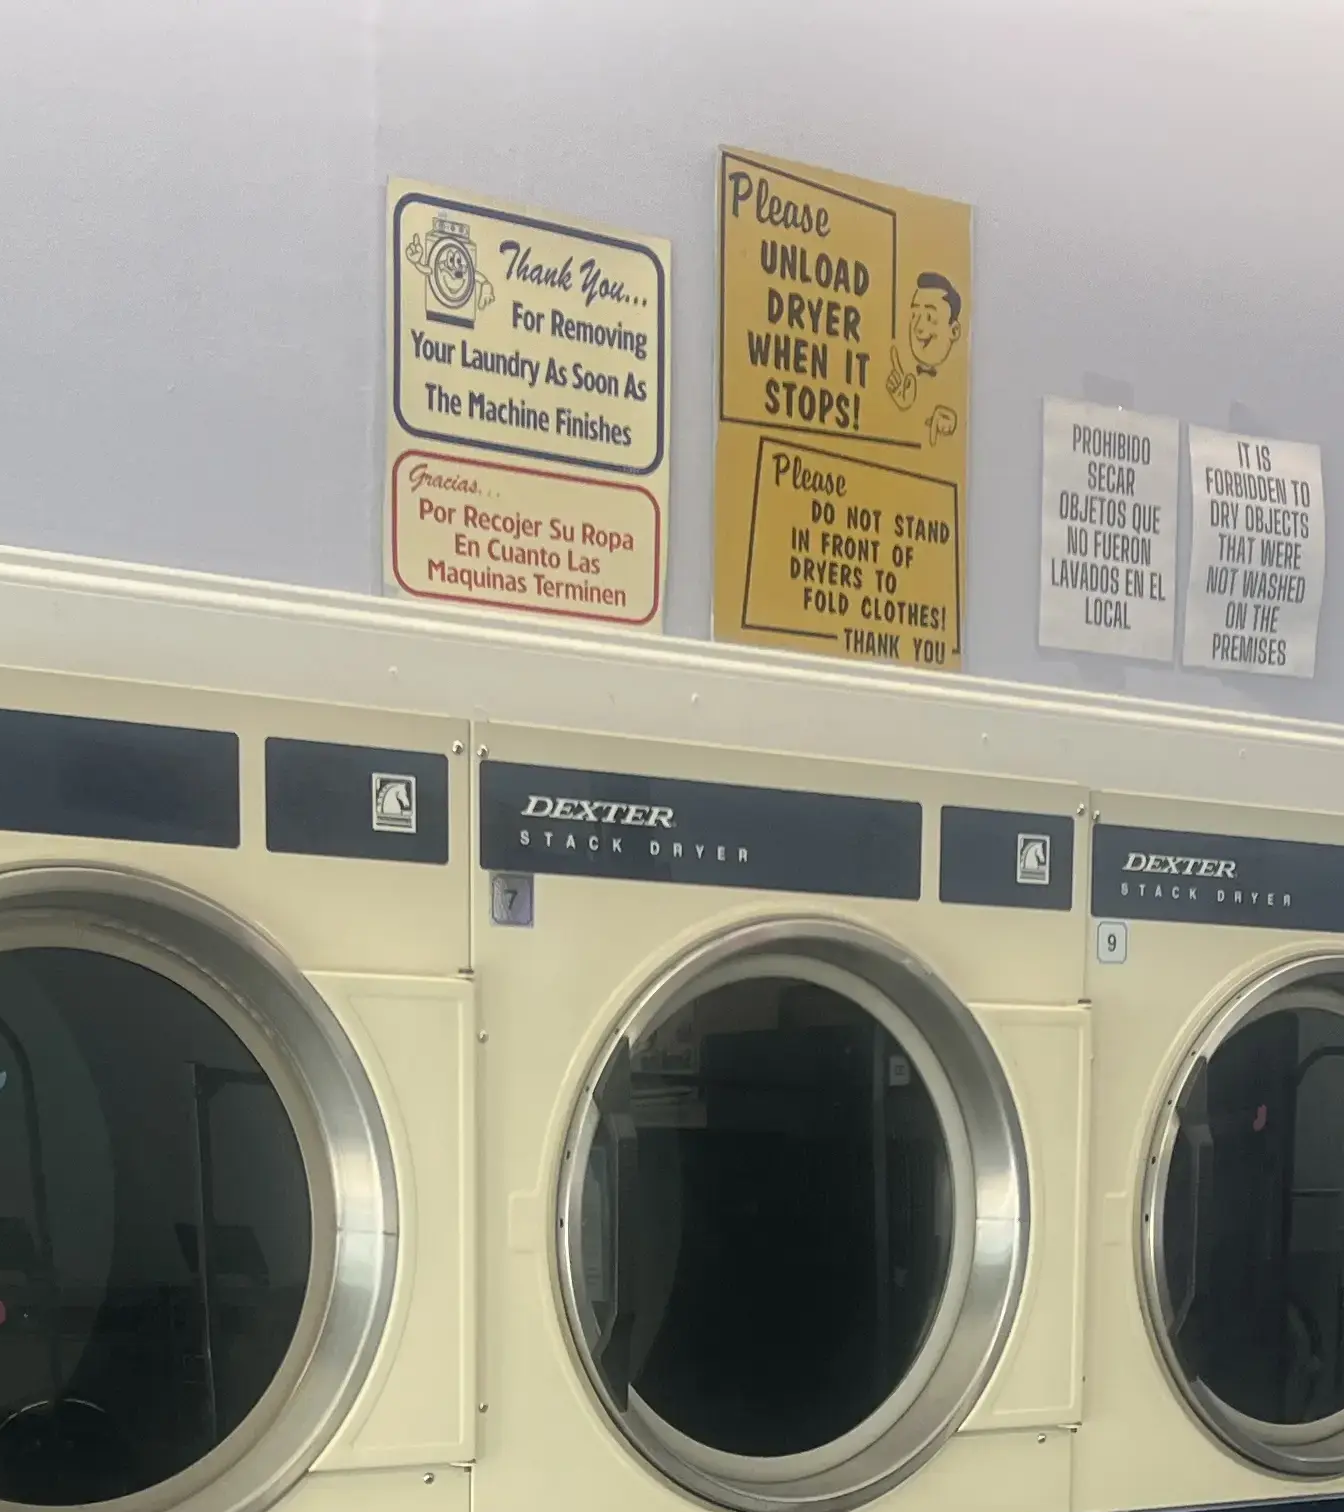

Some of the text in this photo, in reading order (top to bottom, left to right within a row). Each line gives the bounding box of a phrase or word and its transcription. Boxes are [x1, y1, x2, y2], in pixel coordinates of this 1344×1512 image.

[728, 171, 831, 237] Please
[499, 239, 648, 307] Thank You...
[760, 239, 870, 297] UNLOAD
[512, 300, 647, 360] For Removing
[767, 287, 861, 344] DRYER
[410, 329, 647, 402] Your Laundry As Soon As
[747, 329, 870, 389] WHEN IT
[425, 382, 632, 447] The Machine Finishes
[764, 376, 861, 431] STOPS!
[1072, 423, 1151, 466] PROHIBIDO
[1237, 441, 1272, 472] IT IS
[772, 452, 847, 498] Please
[1087, 460, 1136, 497] SECAR
[1205, 467, 1311, 508] FORBIDDEN TO
[419, 498, 634, 553] Por Recojer Su Ropa
[811, 498, 950, 545] DO NOT STAND
[1059, 490, 1161, 535] OBJETOS QUE
[1210, 500, 1310, 539] DRY OBJECTS
[455, 533, 600, 575] En Cuanto Las
[791, 527, 914, 570] IN FRONT OF
[1067, 525, 1152, 567] NO FUERON
[1217, 532, 1302, 570] THAT WERE
[427, 558, 627, 607] Maquinas Terminen
[790, 555, 898, 595] DRYERS TO
[1051, 557, 1166, 602] LAVADOS EN EL
[1206, 565, 1306, 604] NOT WASHED
[803, 586, 947, 631] FOLD CLOTHES!
[1085, 596, 1131, 630] LOCAL
[1225, 600, 1280, 633] ON THE
[843, 627, 946, 665] THANK YOU
[1212, 632, 1287, 667] PREMISES
[520, 795, 674, 828] DEXTER
[519, 829, 748, 863] STACK DRYER
[1122, 852, 1237, 880] DEXTER
[506, 889, 518, 912] 7
[1120, 883, 1291, 906] STACK DRYER
[1106, 934, 1117, 951] 9
